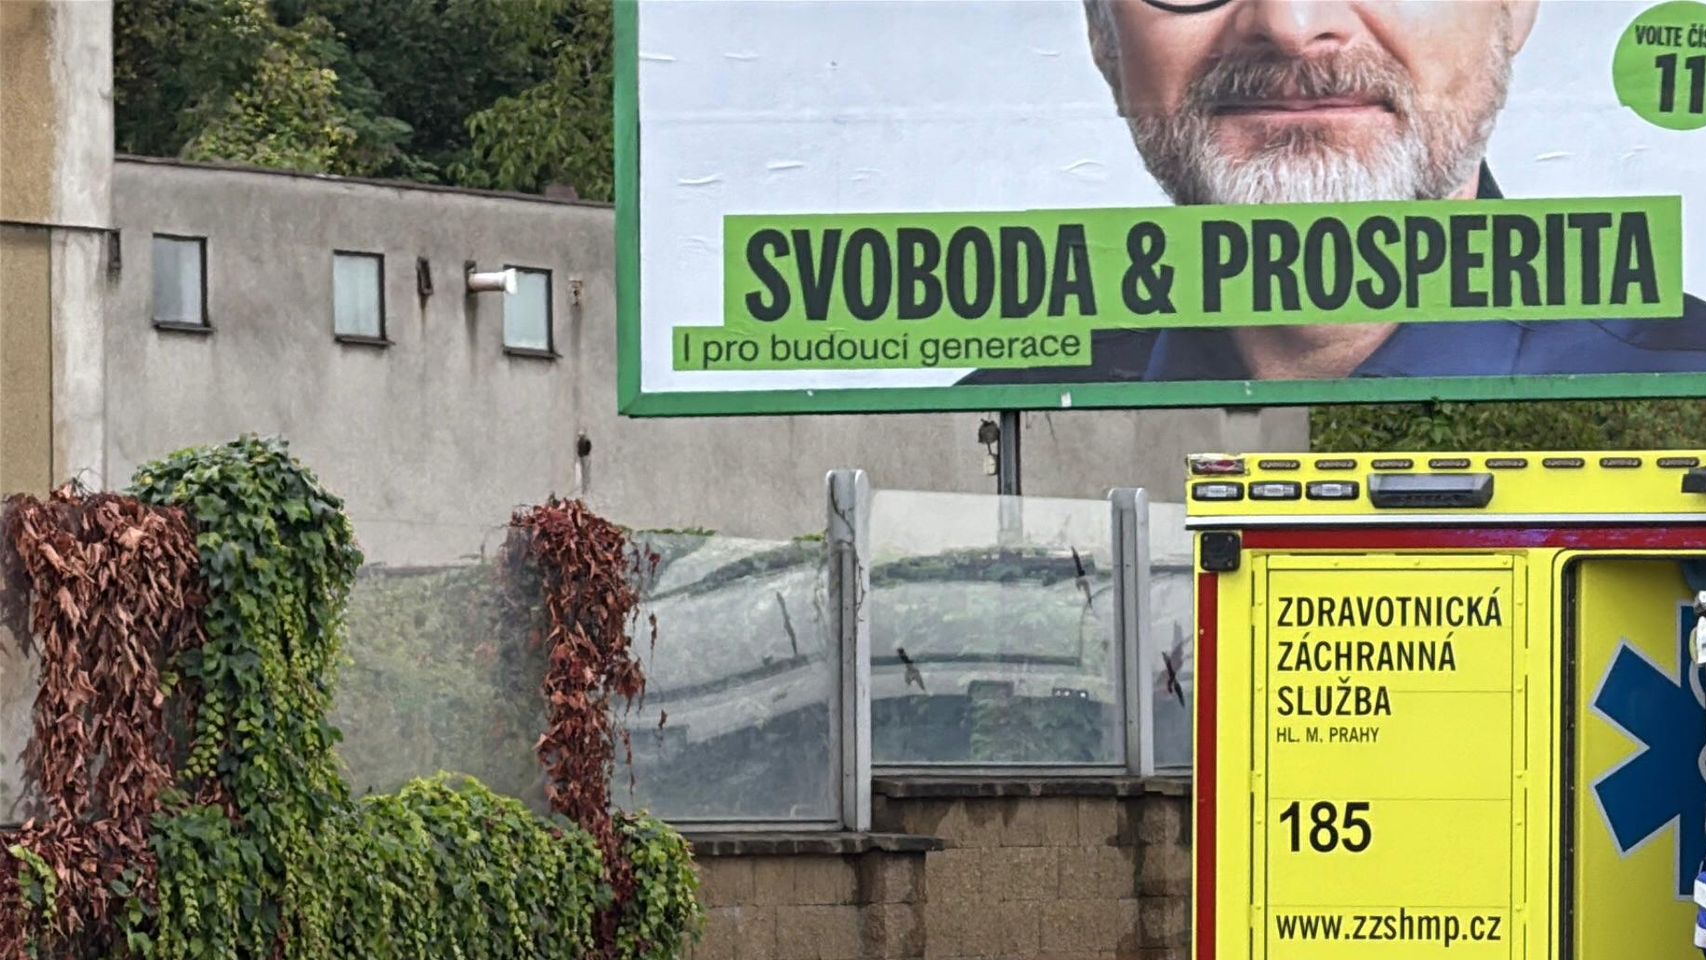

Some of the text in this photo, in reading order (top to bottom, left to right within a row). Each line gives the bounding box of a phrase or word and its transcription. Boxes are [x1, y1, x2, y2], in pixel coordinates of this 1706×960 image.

[1636, 25, 1683, 49] VOLTE
[1655, 54, 1706, 115] 11
[745, 211, 1660, 321] SVOBODA & PROSPERITA
[682, 332, 1081, 369] I pro budoucí generace
[1277, 588, 1502, 627] ZDRAVOTNICKÁ
[1277, 633, 1456, 672] ZÁCHRANNÁ
[1277, 677, 1391, 716] SLUŽBA
[1276, 727, 1380, 743] HL. M. PRAHY
[1279, 801, 1372, 853] 185
[1276, 908, 1502, 947] www.zzshmp.cz
